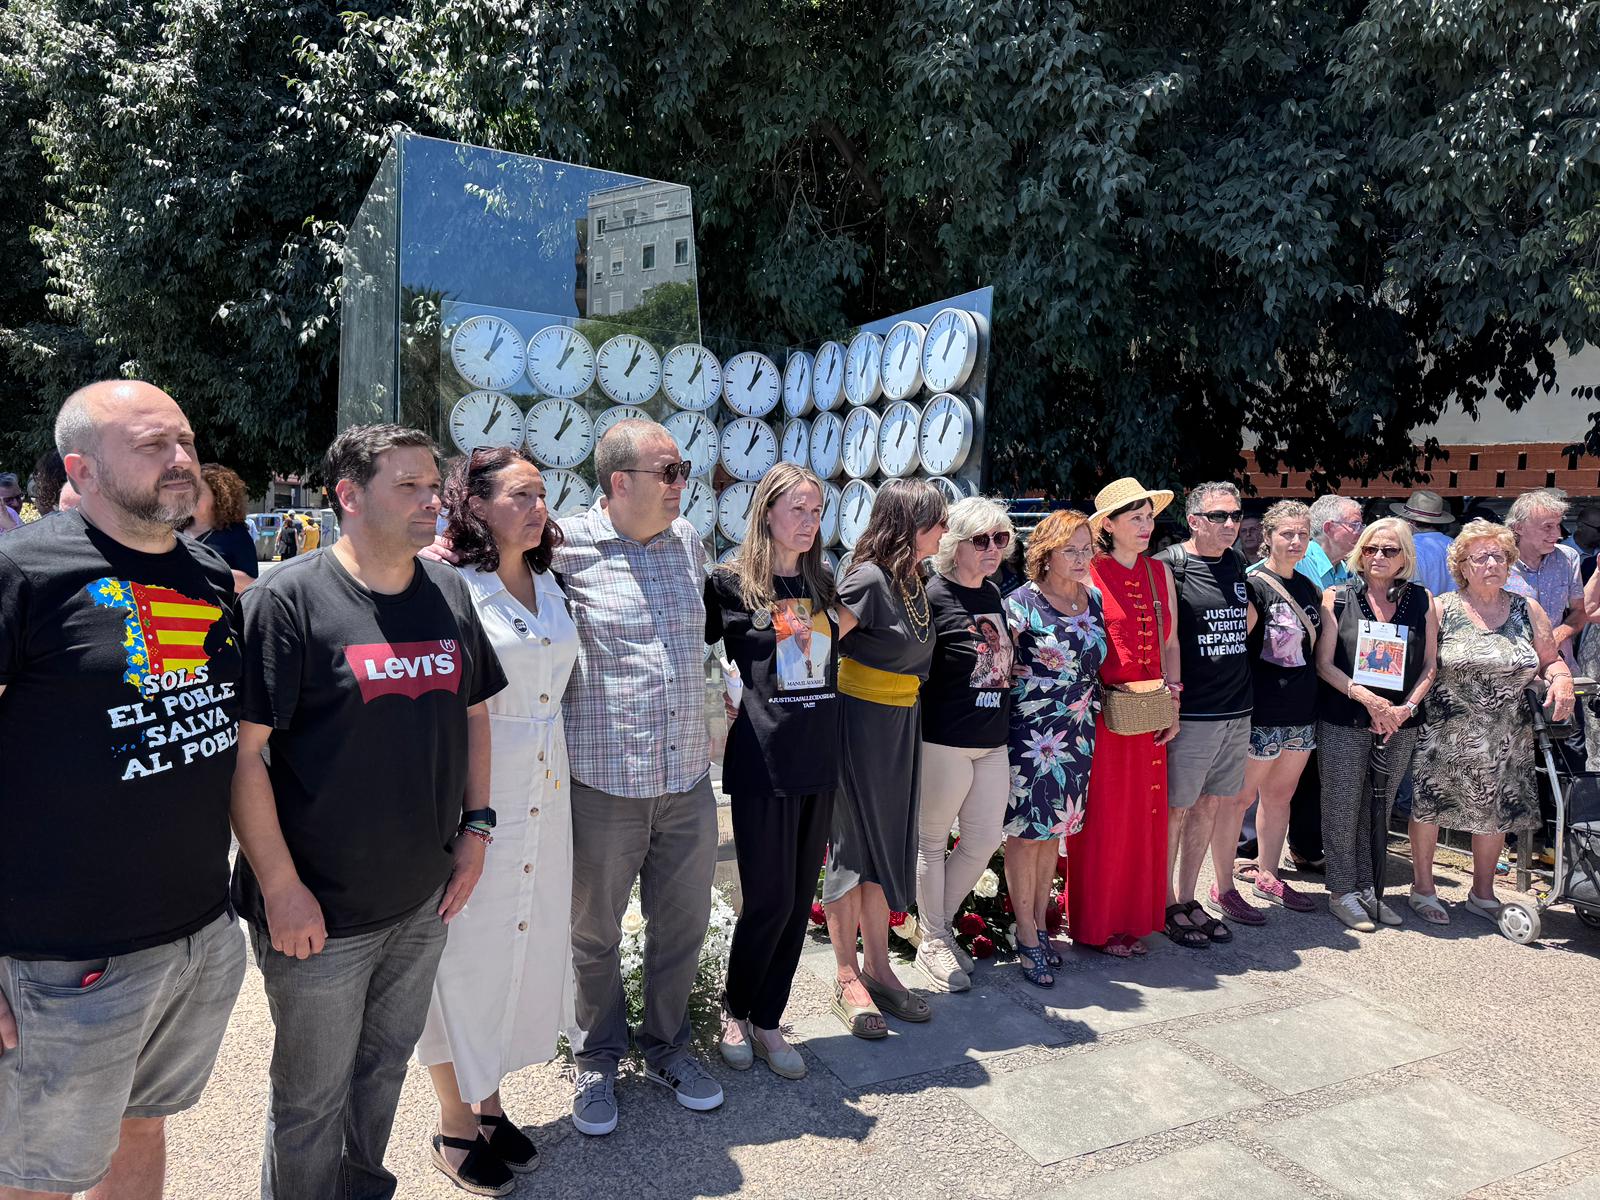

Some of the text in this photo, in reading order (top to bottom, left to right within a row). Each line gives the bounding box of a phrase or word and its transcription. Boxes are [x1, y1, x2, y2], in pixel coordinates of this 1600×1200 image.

[1208, 620, 1247, 632] VERITAT
[1200, 646, 1205, 656] I
[143, 665, 209, 694] SOLS
[107, 682, 235, 729] EL POBLE
[975, 691, 1002, 708] ROSA
[145, 707, 230, 748] SALVA
[121, 753, 173, 781] AL
